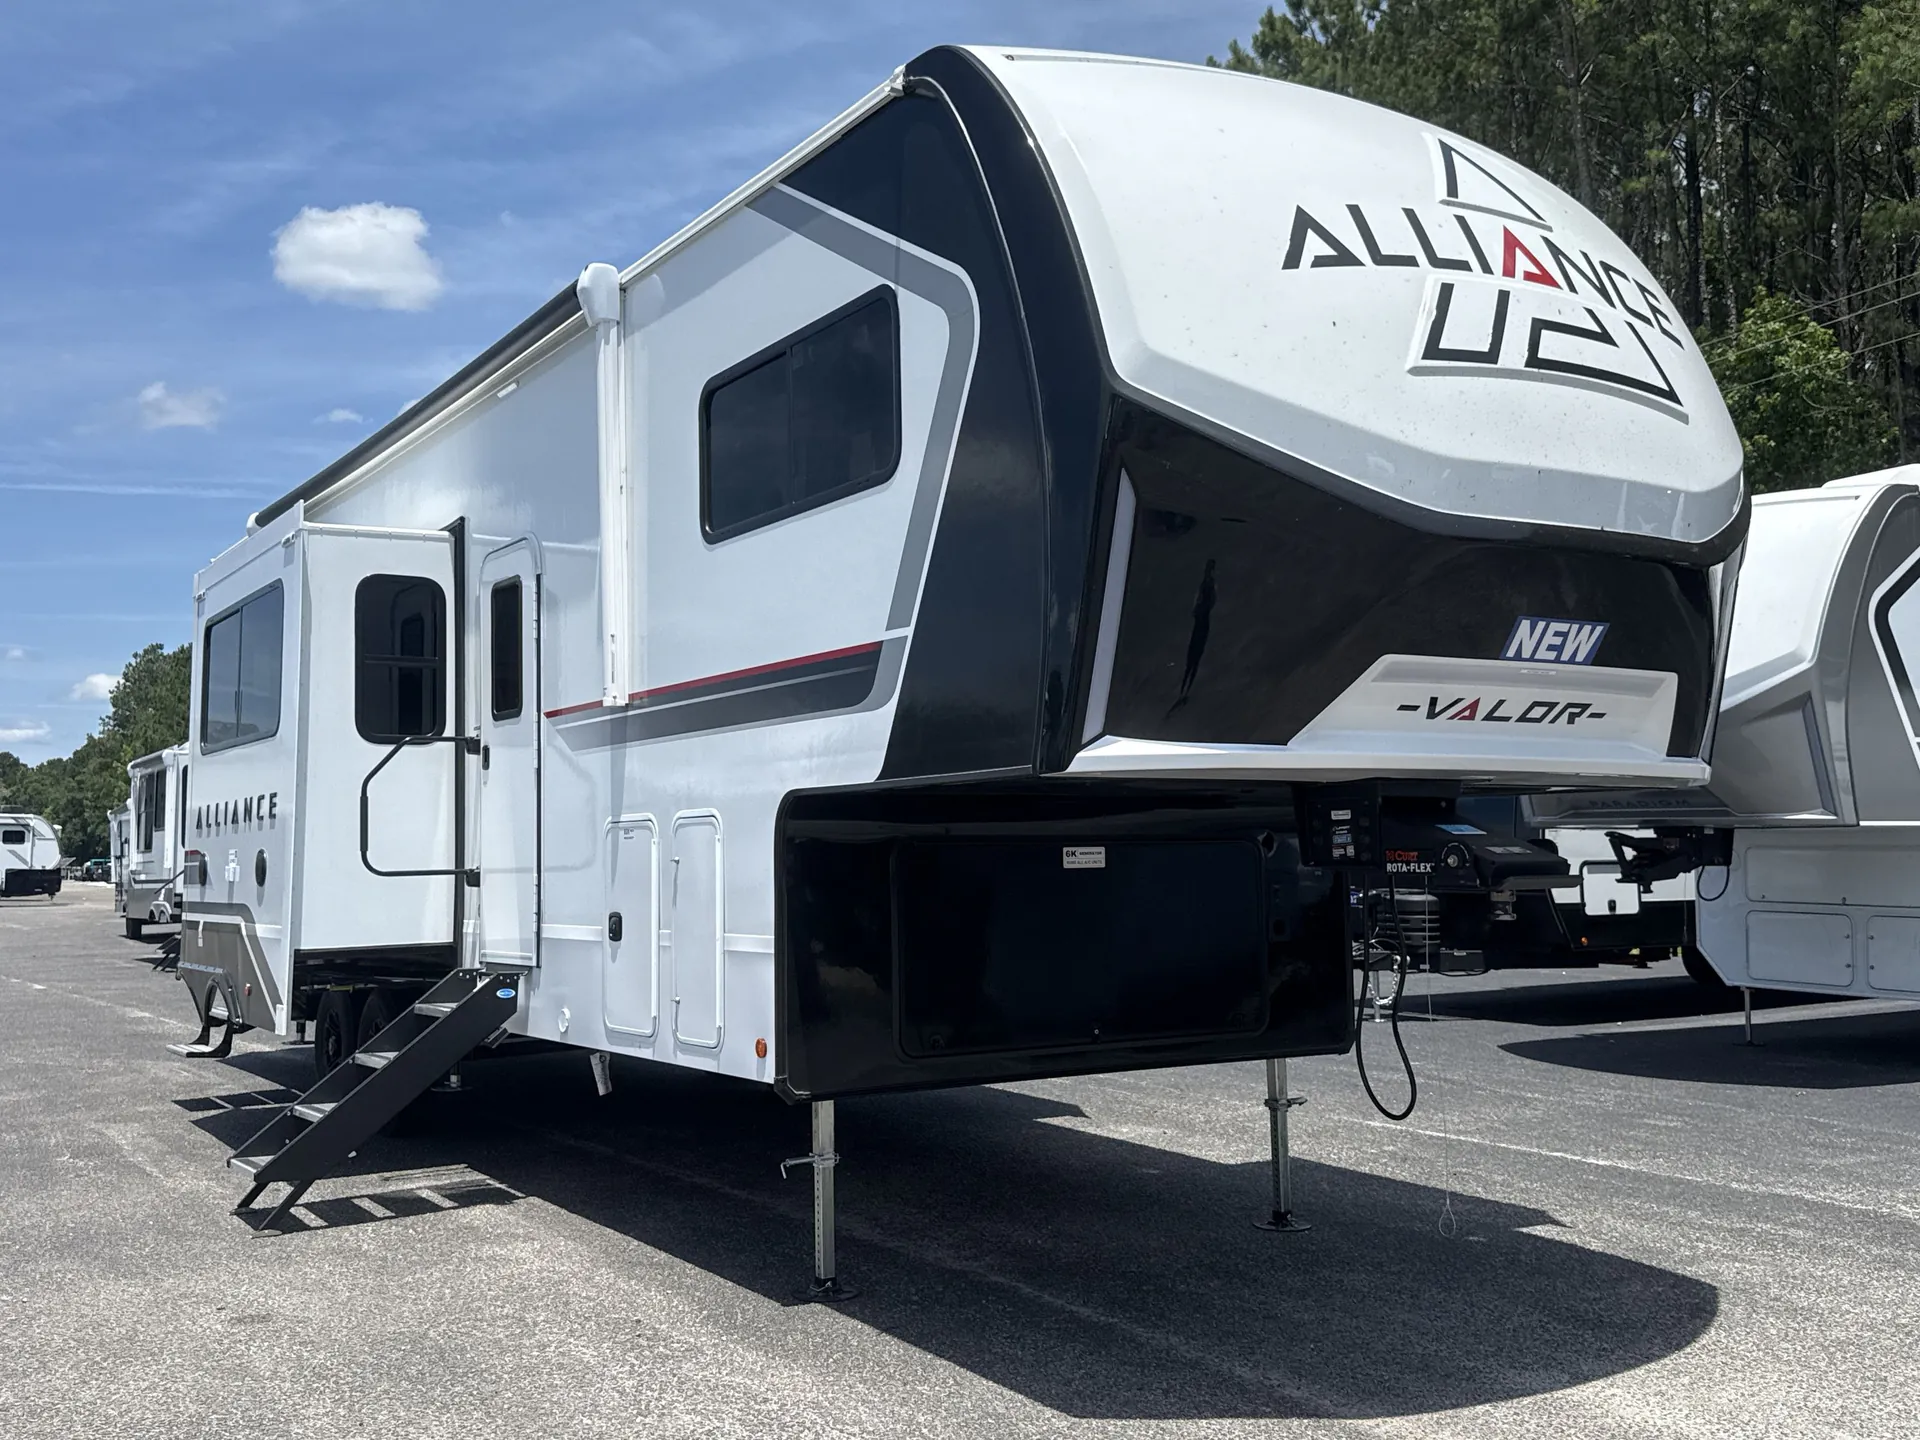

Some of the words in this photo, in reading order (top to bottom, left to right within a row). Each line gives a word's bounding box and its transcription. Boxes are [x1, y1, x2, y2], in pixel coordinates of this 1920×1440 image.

[1281, 203, 1685, 350] ALLIANCE
[1505, 619, 1604, 662] NEW
[195, 791, 278, 830] ALLIANCE
[1065, 850, 1077, 858] 6K
